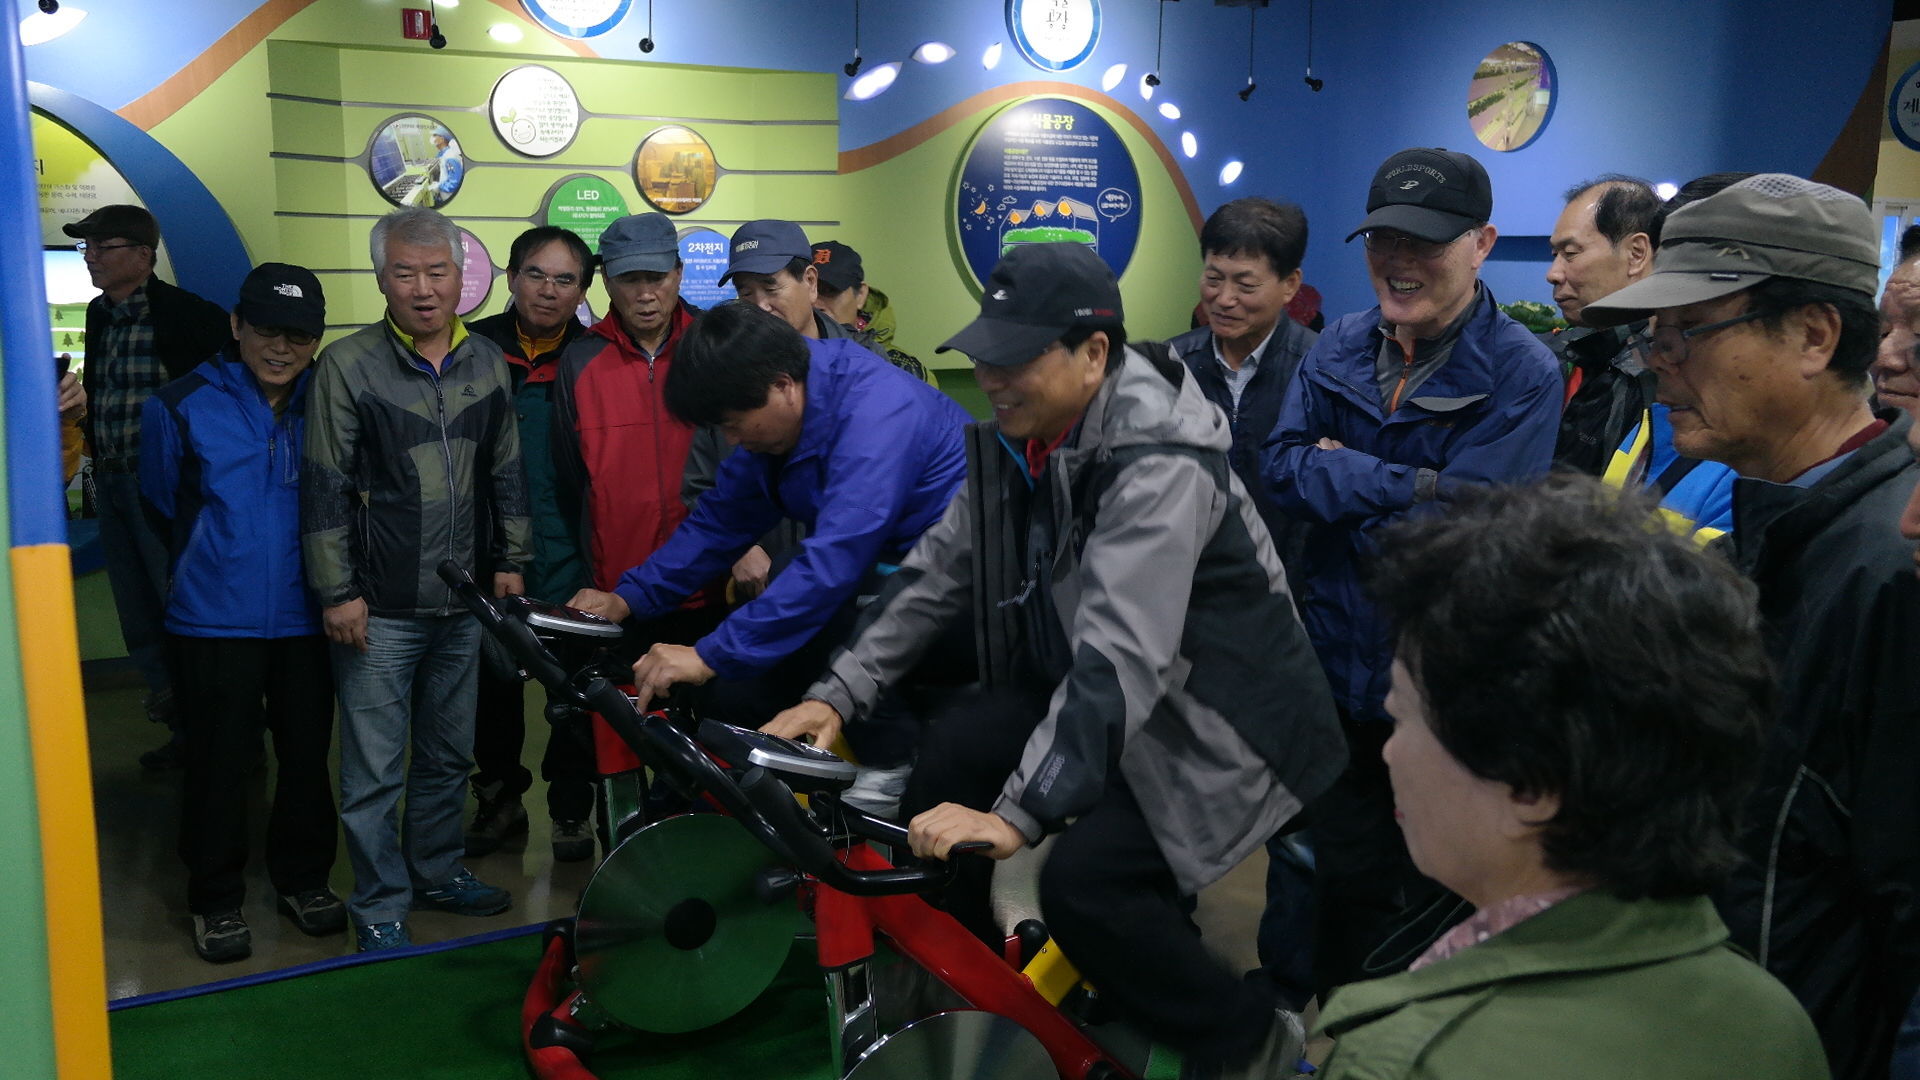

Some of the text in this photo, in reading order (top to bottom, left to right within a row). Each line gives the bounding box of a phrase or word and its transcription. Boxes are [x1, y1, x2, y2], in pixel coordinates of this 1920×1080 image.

[1033, 113, 1075, 131] 식물공장
[577, 190, 600, 200] LED
[688, 243, 724, 255] 2차전지
